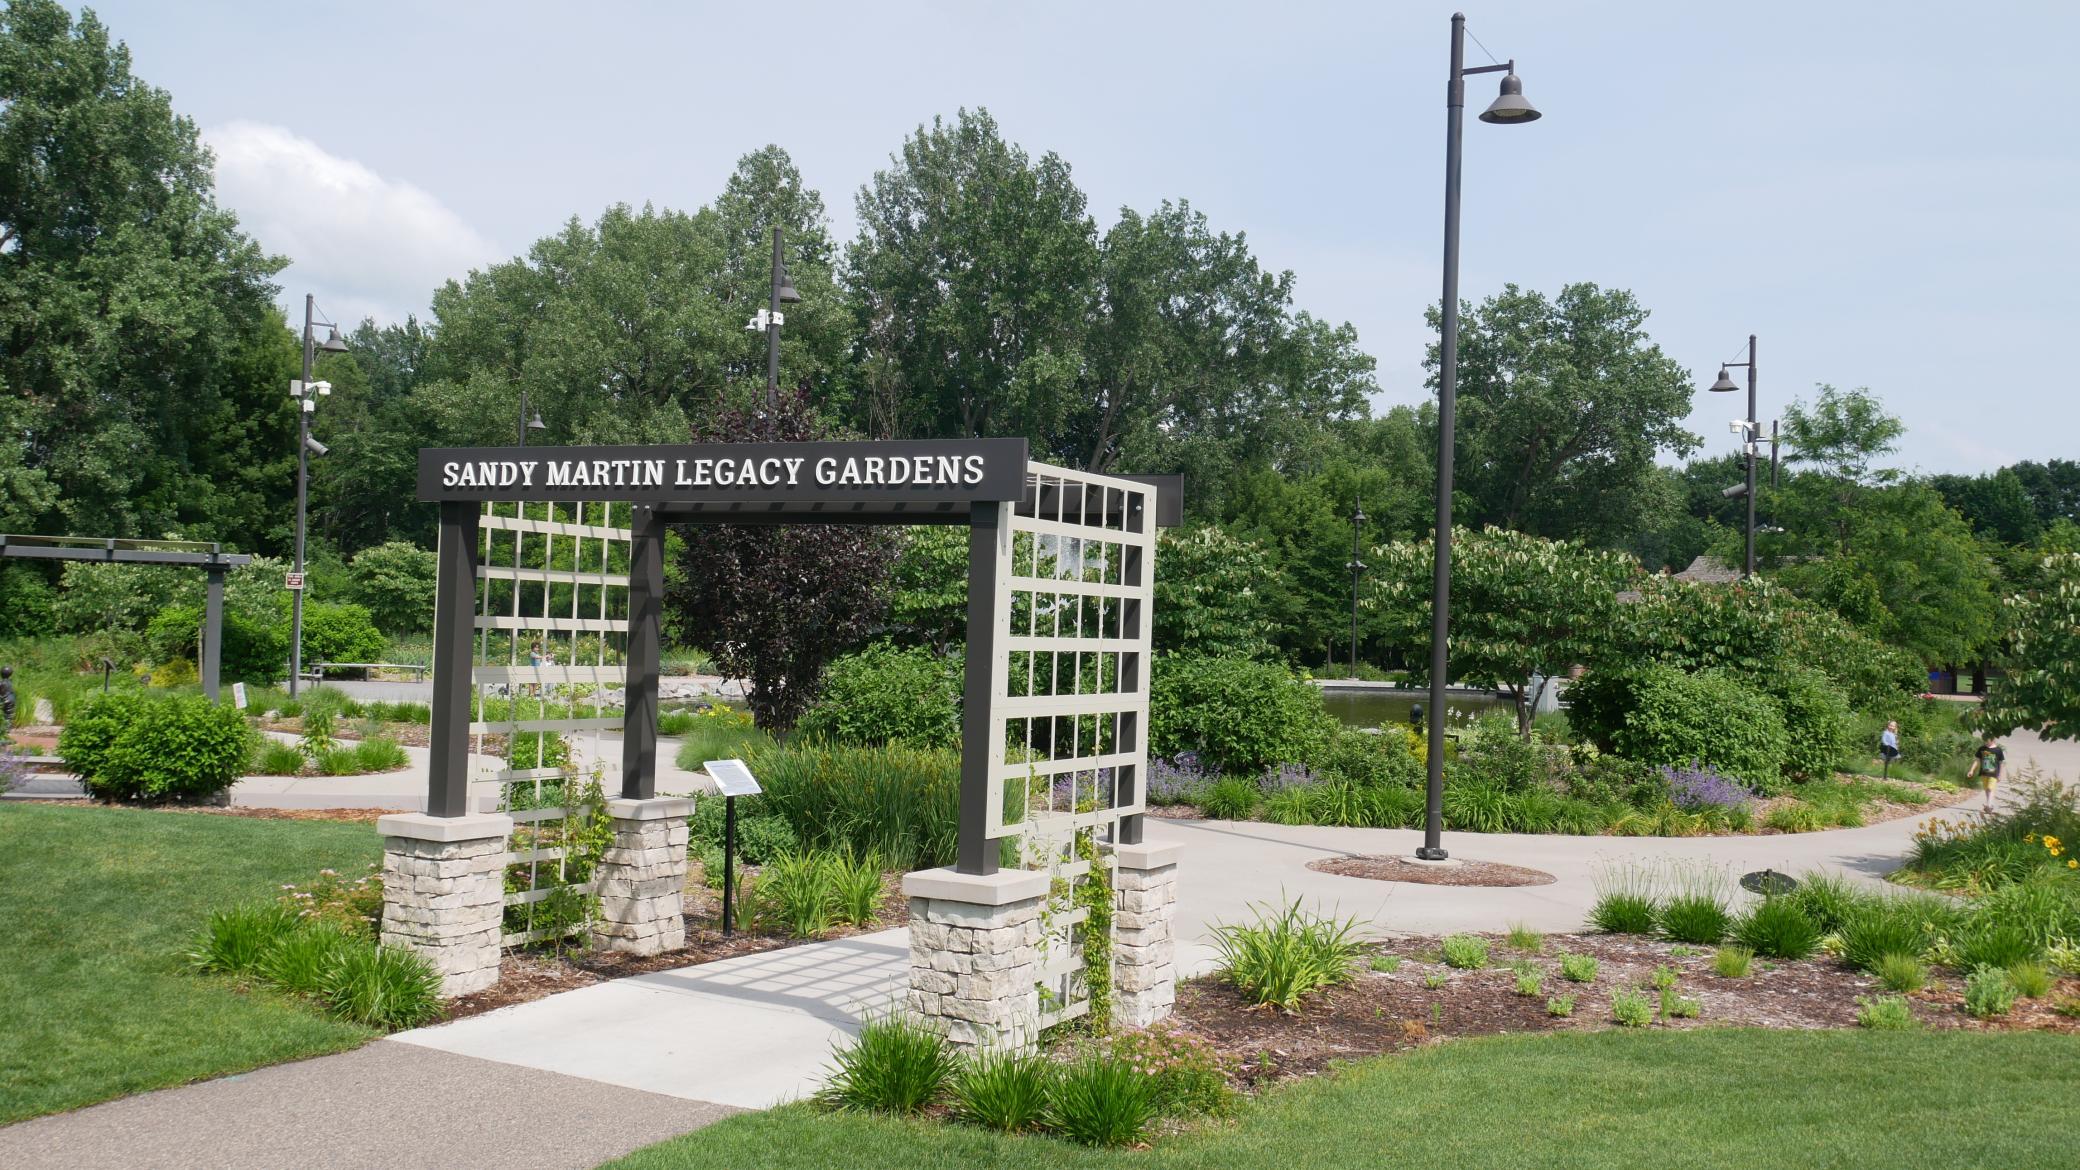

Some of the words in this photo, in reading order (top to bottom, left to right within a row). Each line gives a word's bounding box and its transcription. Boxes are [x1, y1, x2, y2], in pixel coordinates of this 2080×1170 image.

[442, 461, 538, 486] SANDY
[545, 460, 665, 485] MARTIN
[674, 458, 804, 485] LEGACY
[815, 455, 984, 484] GARDENS
